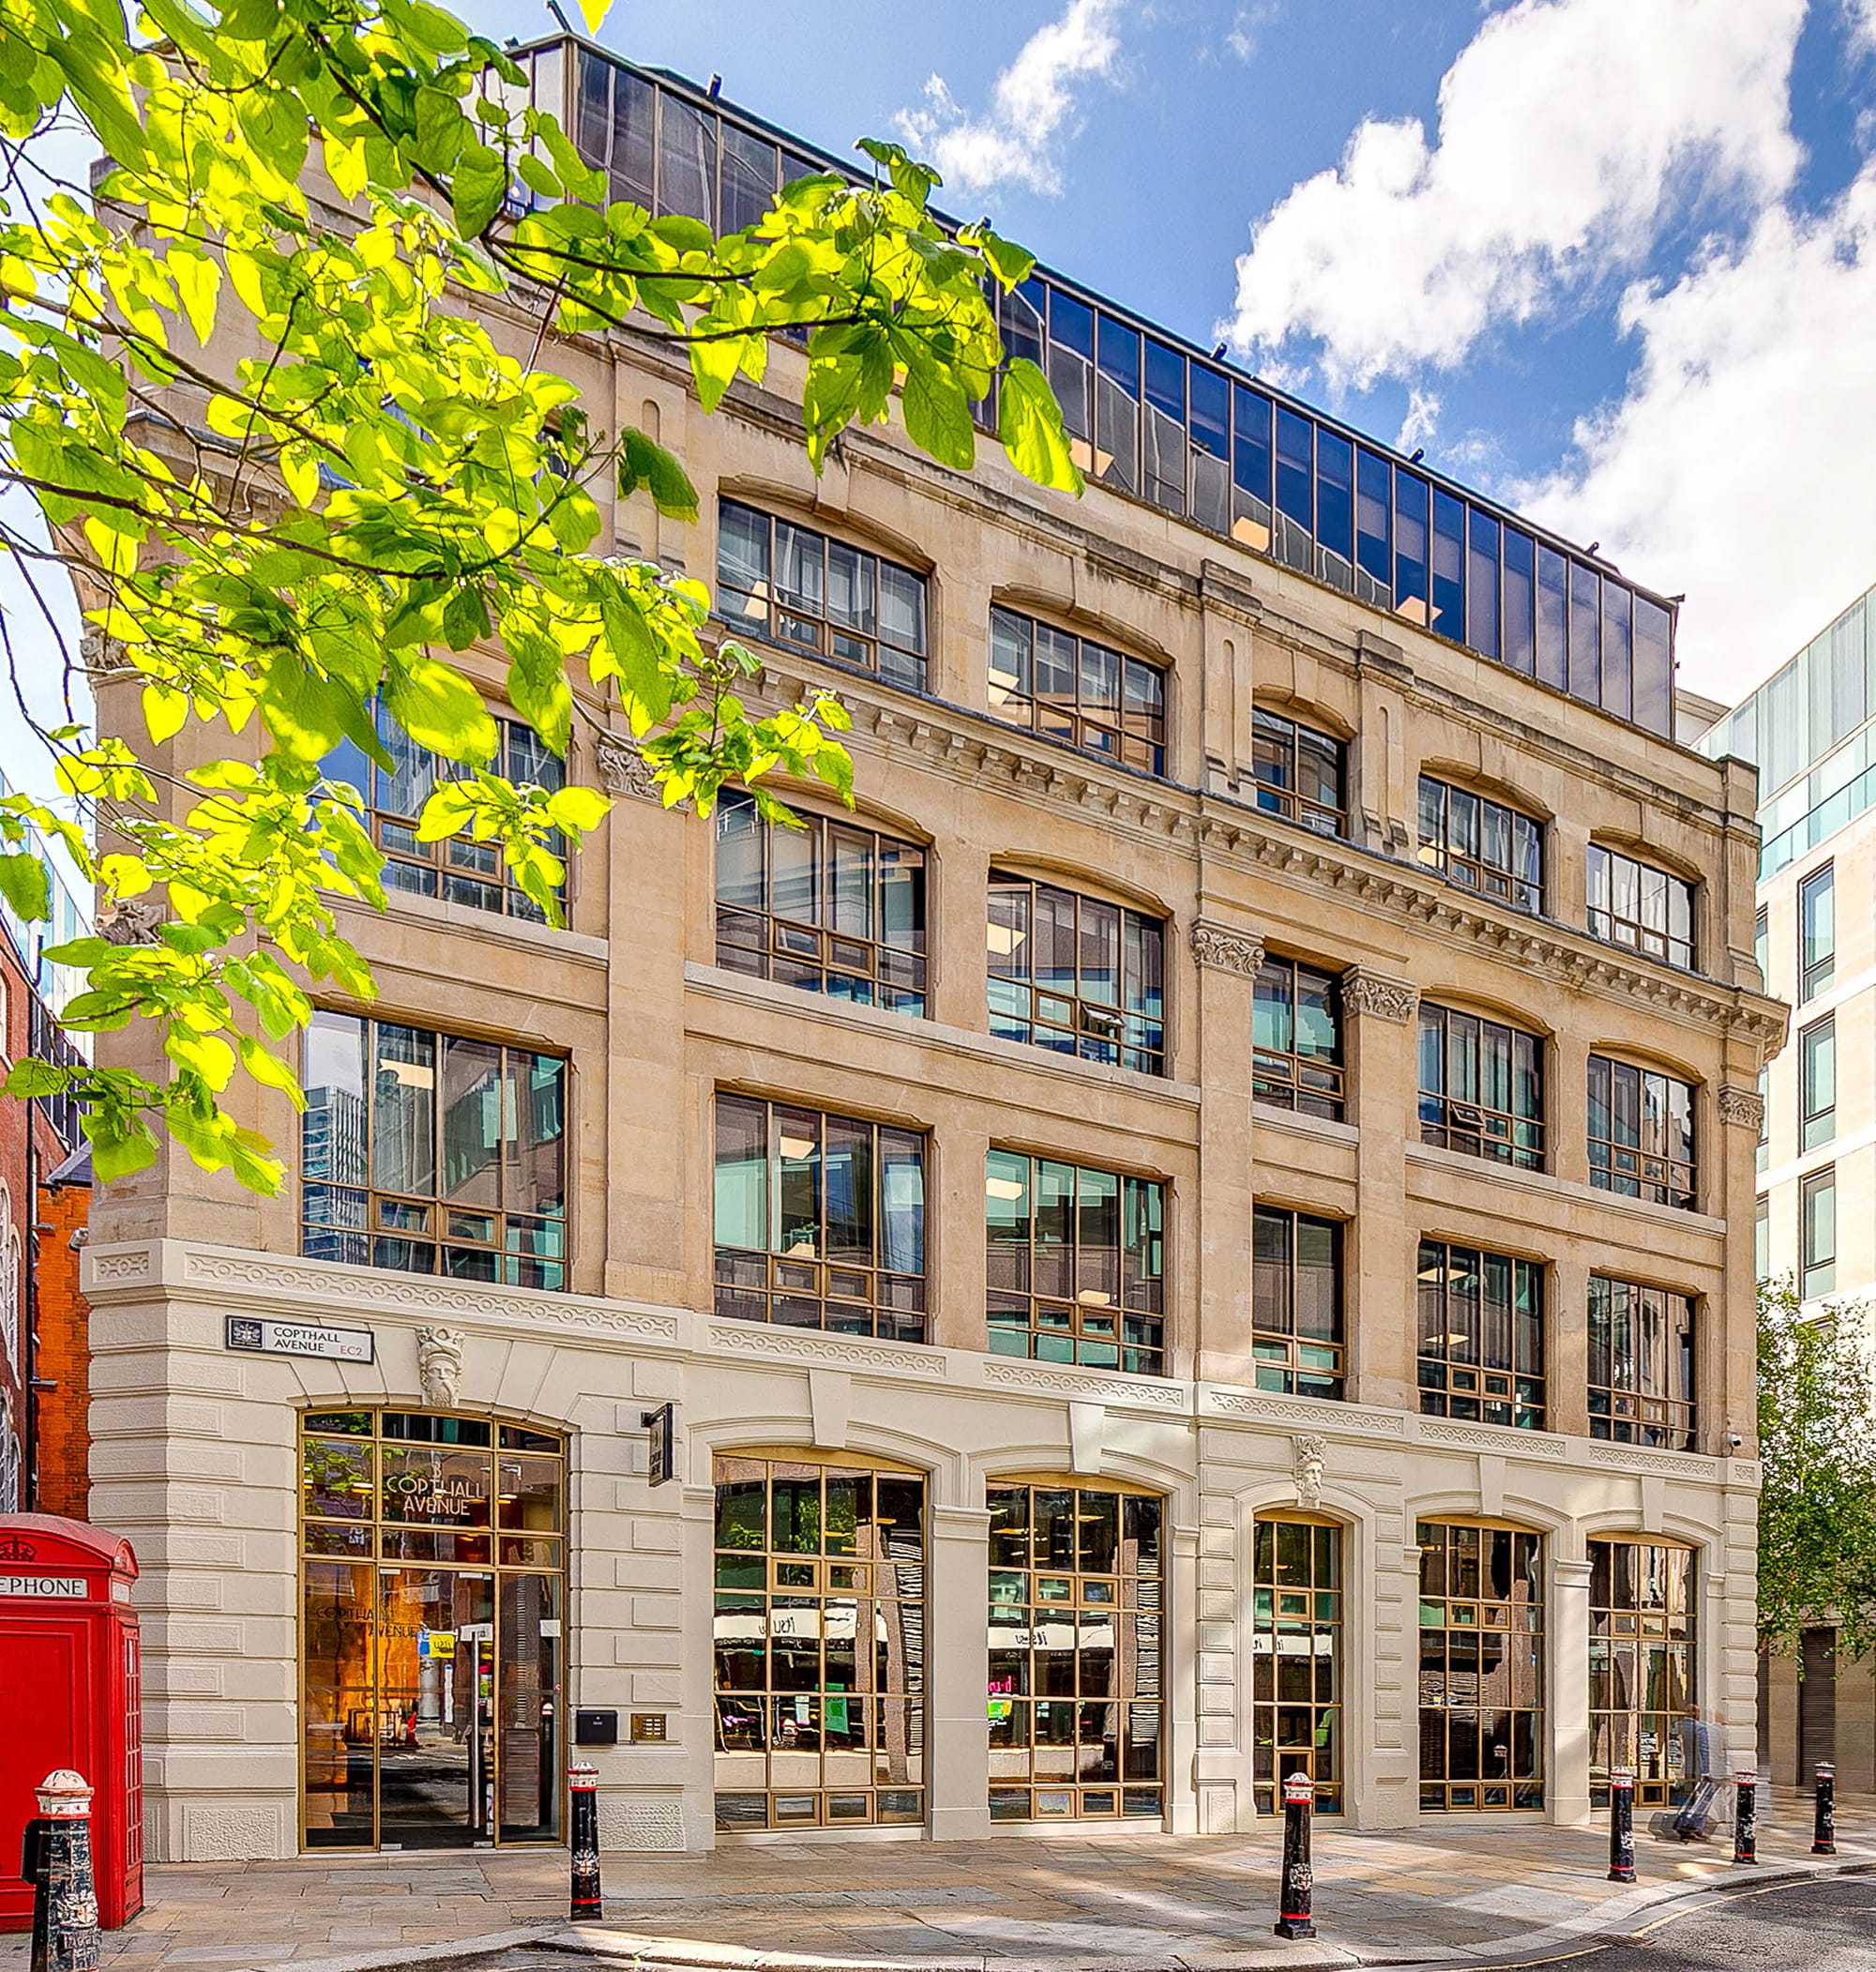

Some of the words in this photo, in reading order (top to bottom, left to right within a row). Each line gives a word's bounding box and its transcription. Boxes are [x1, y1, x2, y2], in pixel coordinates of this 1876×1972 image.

[274, 1327, 341, 1343] COPTHALL
[274, 1339, 325, 1353] AVENUE
[340, 1344, 363, 1357] EC2
[386, 1476, 485, 1499] COPTHALL
[403, 1494, 471, 1516] AVENUE
